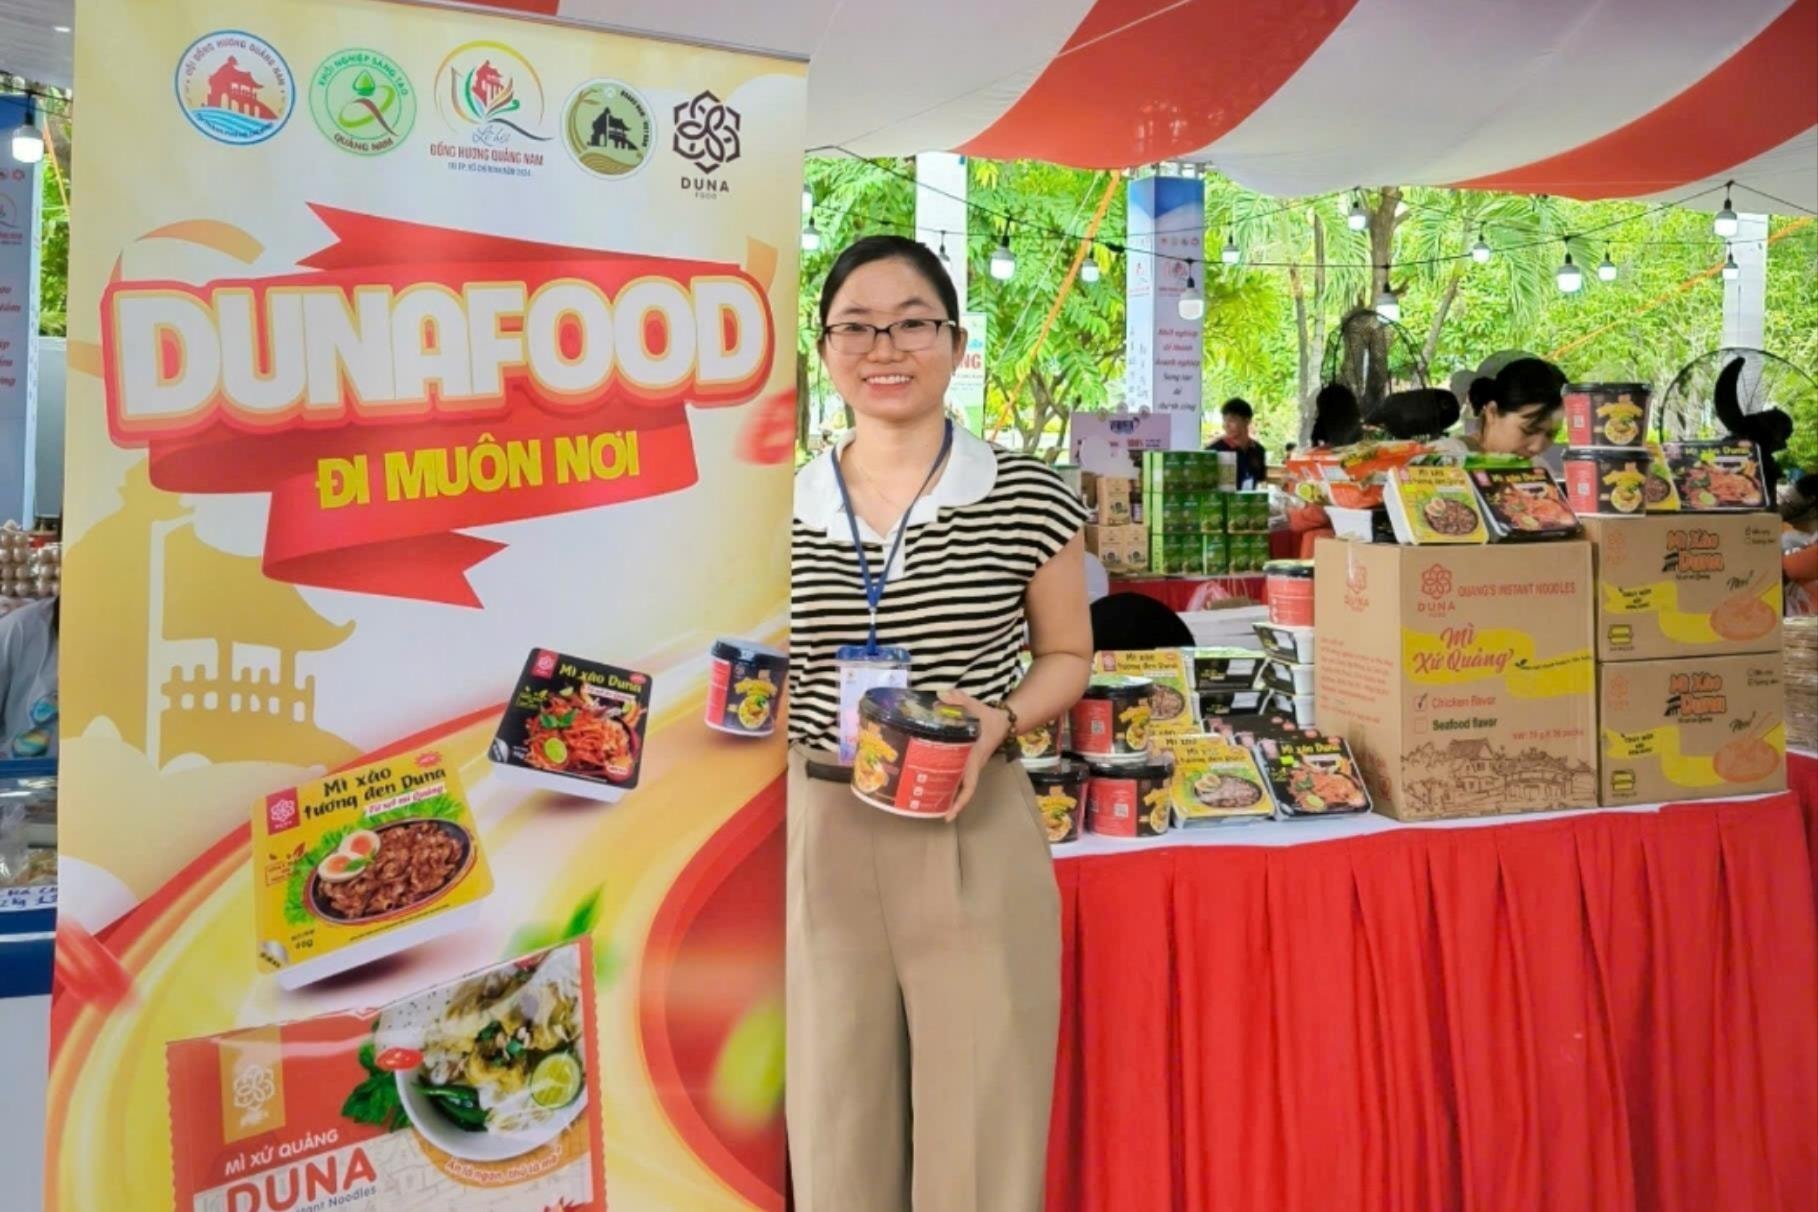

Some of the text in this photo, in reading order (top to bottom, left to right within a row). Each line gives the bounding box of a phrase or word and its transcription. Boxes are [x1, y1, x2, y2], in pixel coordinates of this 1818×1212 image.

[523, 152, 544, 166] NAM
[681, 177, 730, 192] DUNA
[112, 275, 770, 426] DUNAFOOD
[315, 430, 640, 509] ĐI MUÔN NƠI
[1500, 582, 1535, 596] INSTANT
[1536, 581, 1576, 595] NOODLES
[1417, 600, 1456, 613] DUNA
[1440, 622, 1475, 650] Mì
[1446, 647, 1515, 674] Quảng
[1432, 695, 1497, 710] Chicken flavor
[1432, 716, 1498, 732] Seafood flavor
[401, 769, 446, 789] Duna
[225, 1128, 339, 1176] MÌ XỨ QUẢNG
[227, 1147, 376, 1212] DUNA
[329, 1185, 377, 1209] Noodles
